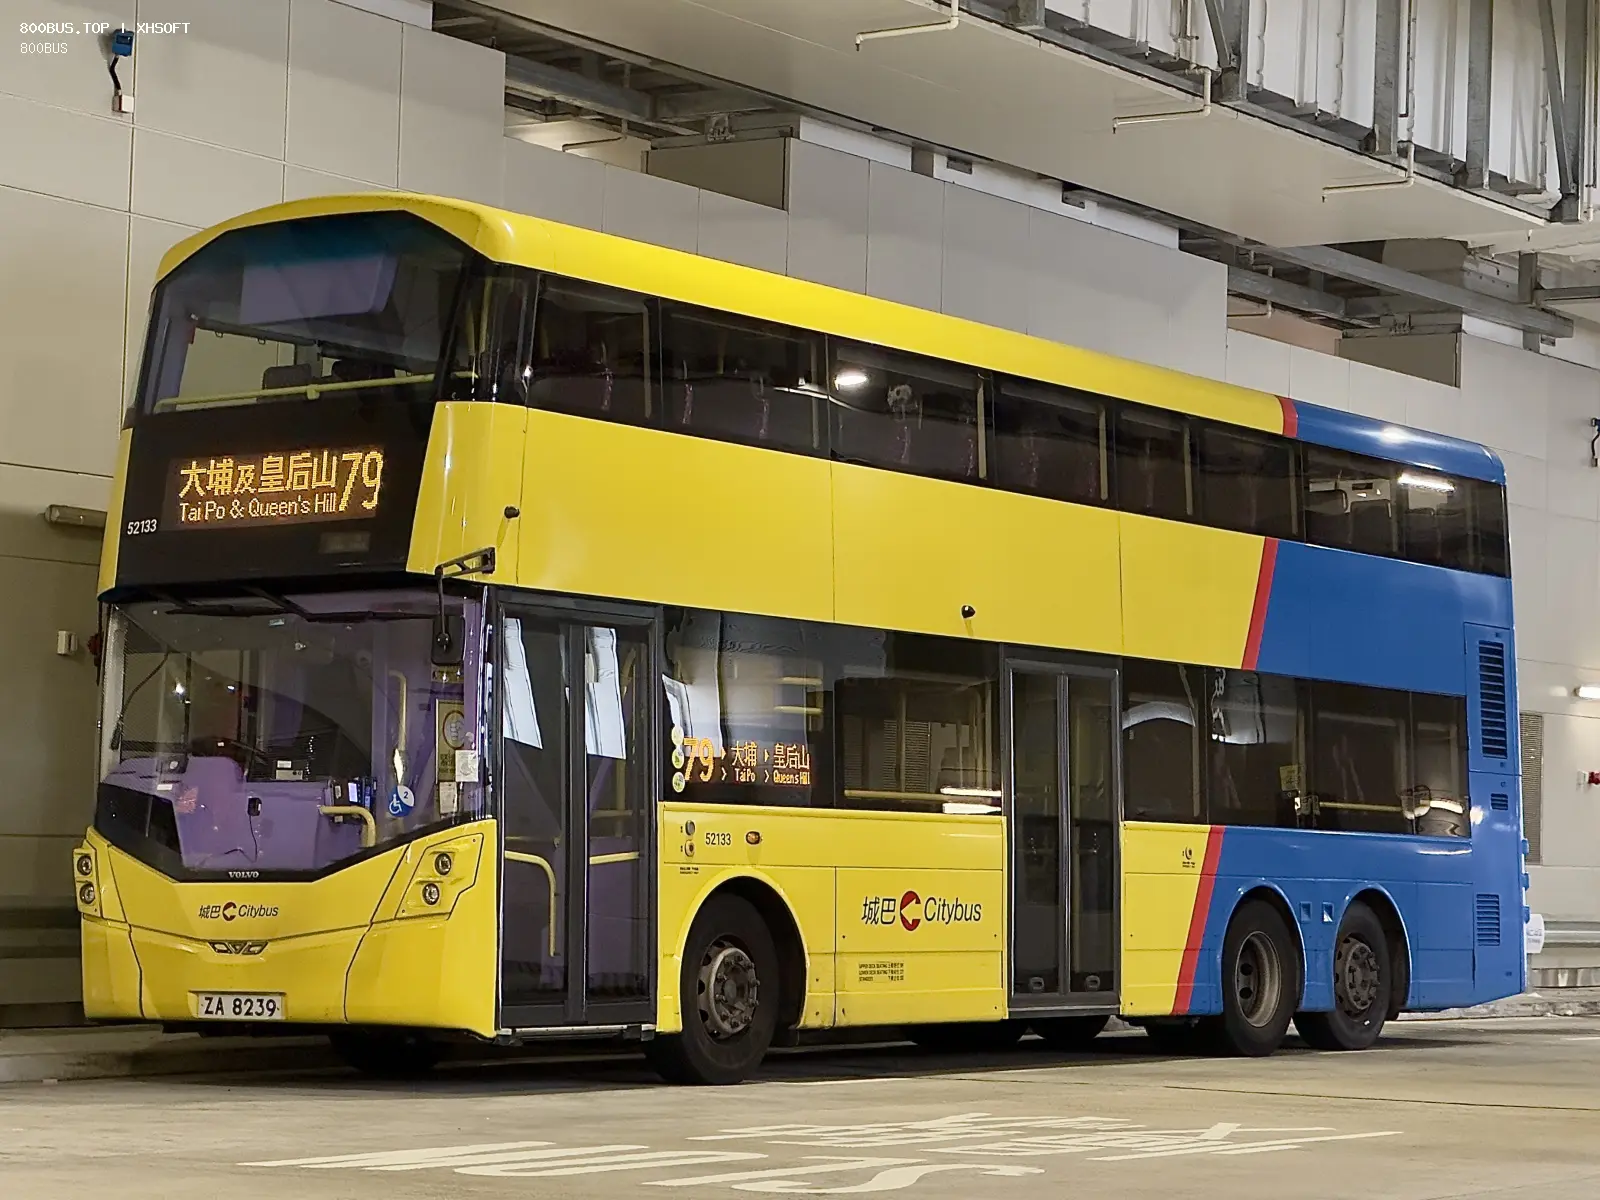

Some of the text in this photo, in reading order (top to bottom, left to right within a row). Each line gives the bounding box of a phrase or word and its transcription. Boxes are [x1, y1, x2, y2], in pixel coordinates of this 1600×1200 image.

[179, 450, 338, 498] 大埔及皇后山
[339, 451, 384, 511] 79
[179, 493, 337, 522] Tai Po & Queen's Hill
[127, 519, 158, 535] 52133
[683, 737, 715, 782] 79
[731, 740, 758, 767] 大埔
[773, 742, 811, 770] 皇后山
[403, 791, 409, 800] 2
[705, 832, 732, 846] 52133
[199, 905, 221, 919] 城巴
[238, 905, 279, 918] Citybus
[861, 896, 897, 925] 城巴
[924, 897, 982, 925] Citybus
[204, 997, 277, 1017] ZA 8239
[236, 1141, 1046, 1194] SLOW
